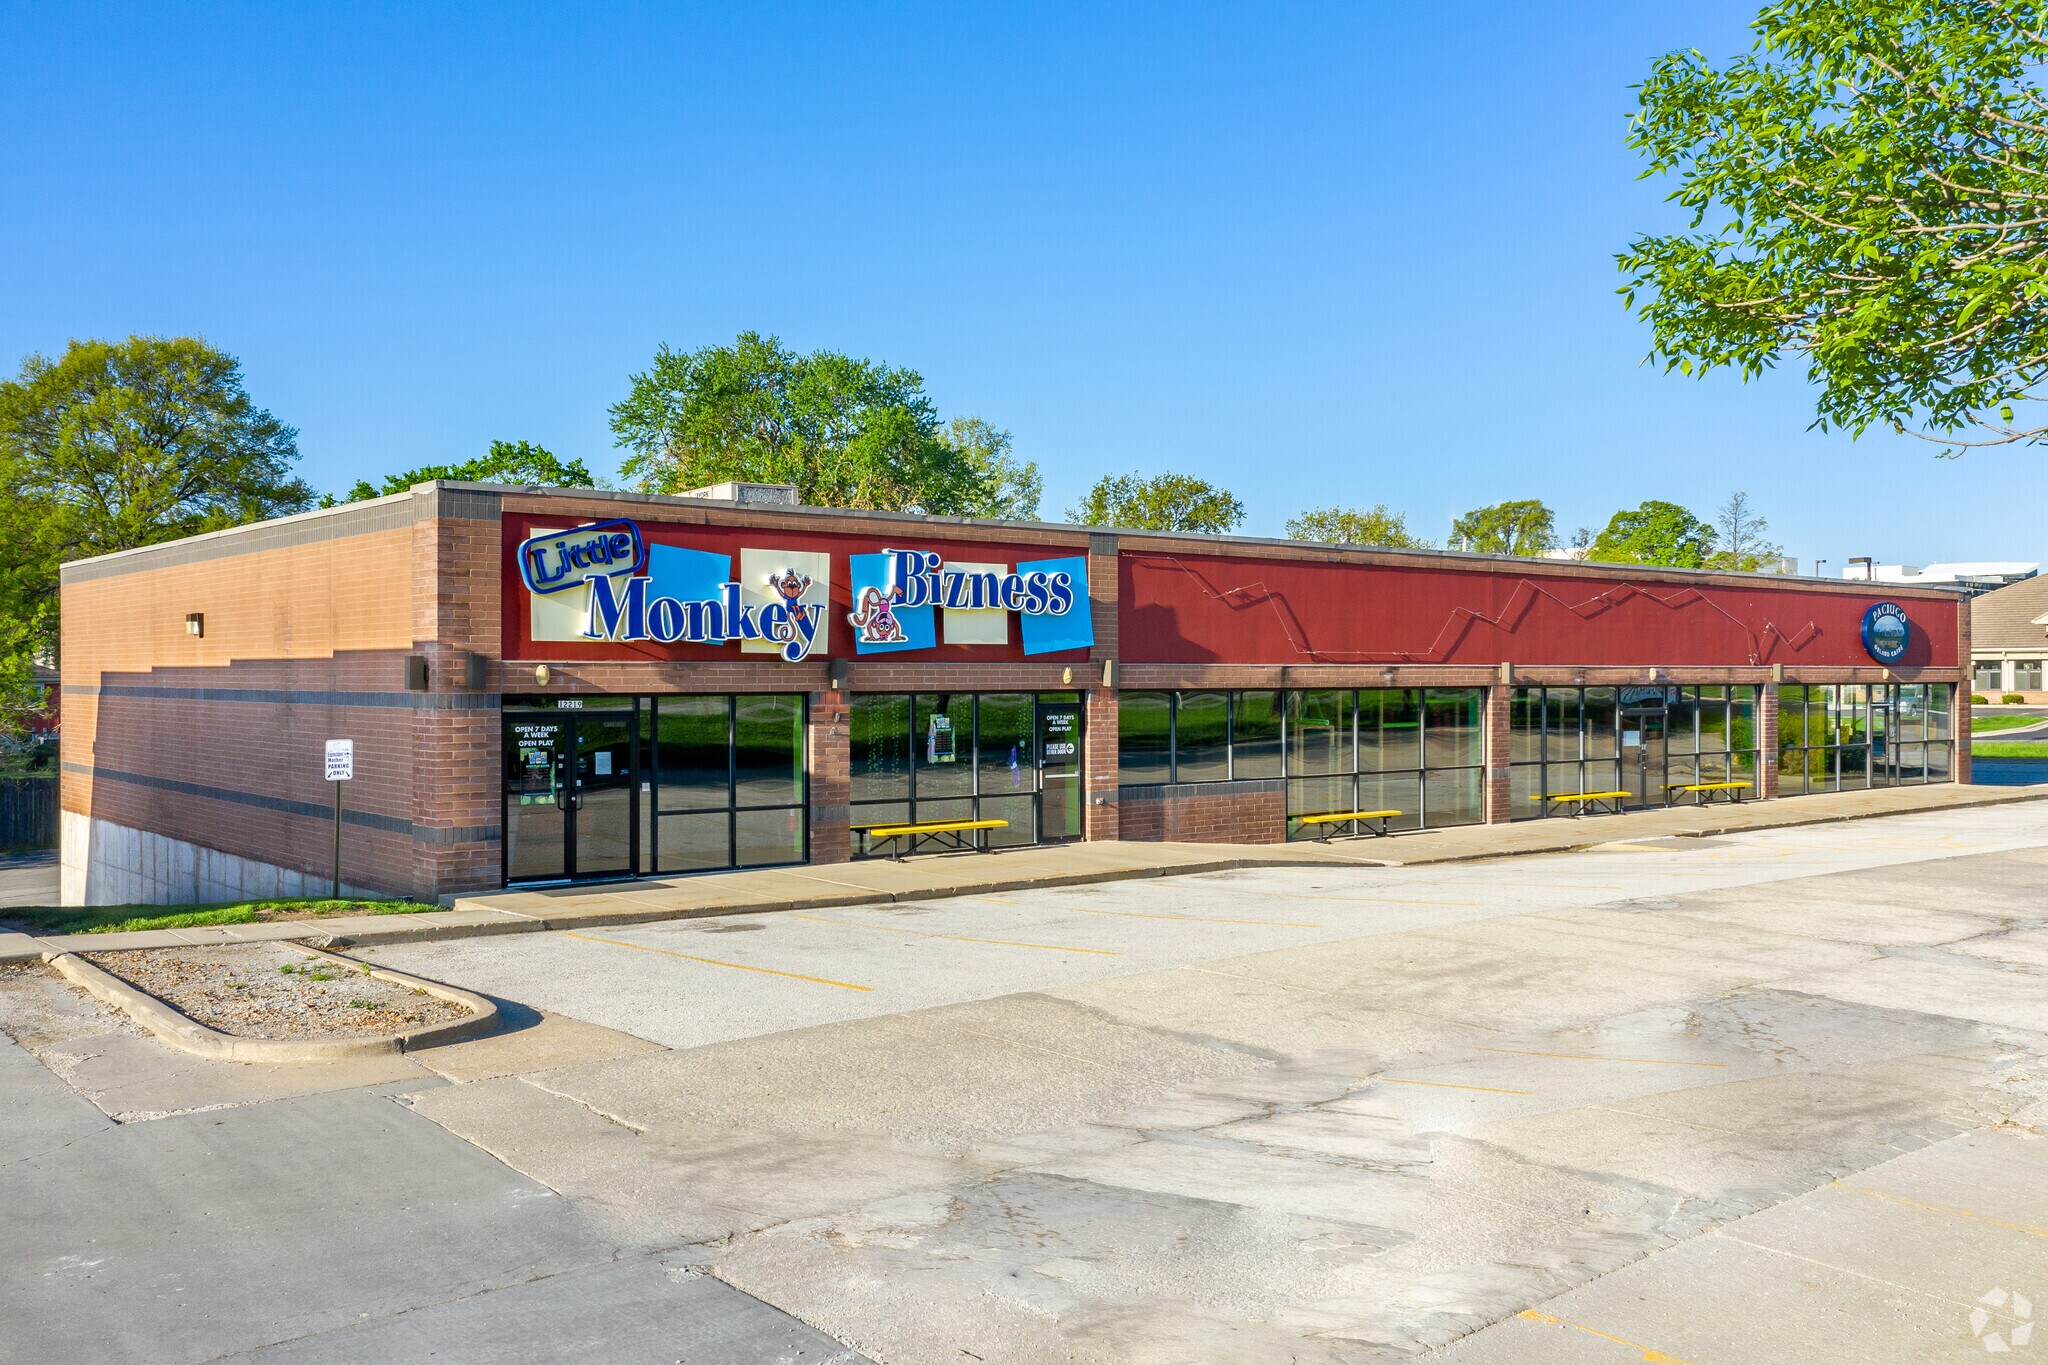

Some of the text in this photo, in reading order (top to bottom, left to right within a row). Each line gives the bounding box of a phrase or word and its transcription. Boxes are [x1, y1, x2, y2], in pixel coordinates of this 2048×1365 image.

[531, 532, 632, 584] Little
[582, 548, 1075, 663] Monkey Bizness
[1872, 603, 1907, 623] PACIUGO
[558, 701, 582, 709] 12219
